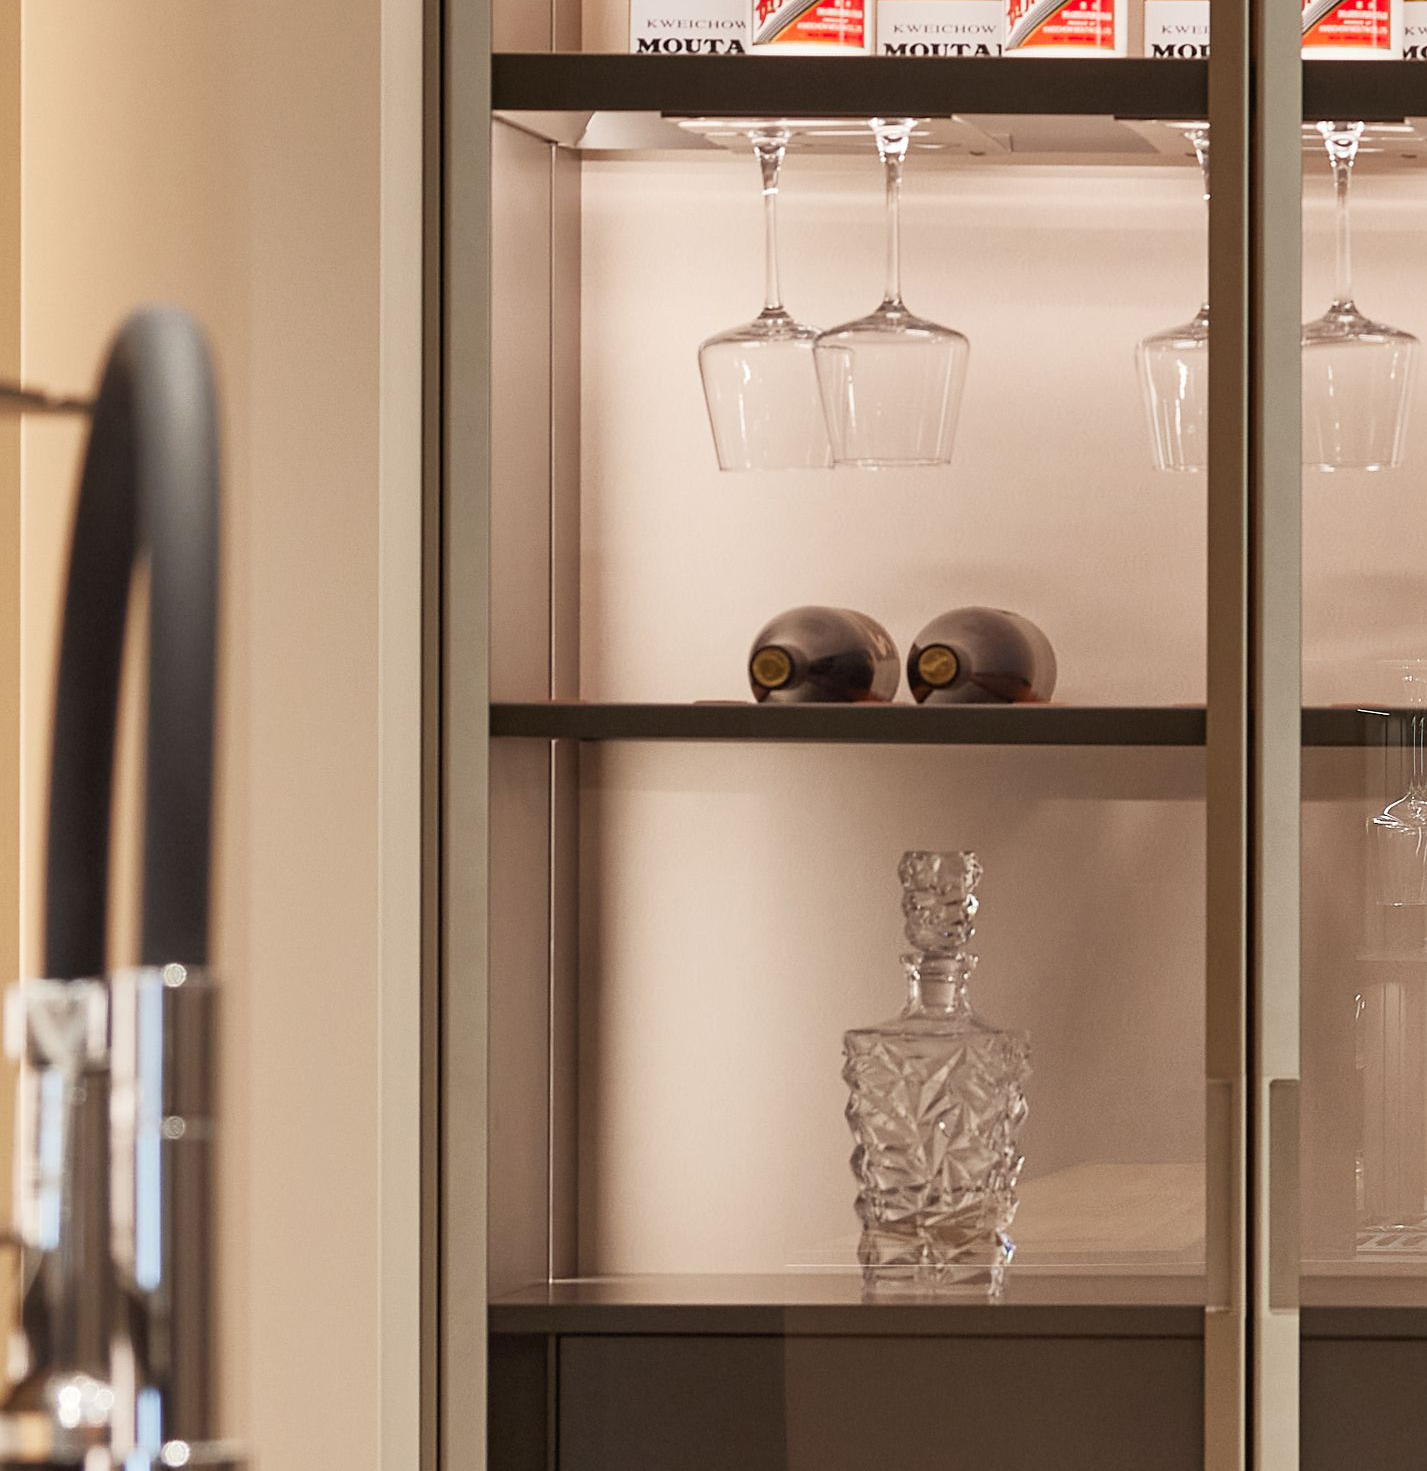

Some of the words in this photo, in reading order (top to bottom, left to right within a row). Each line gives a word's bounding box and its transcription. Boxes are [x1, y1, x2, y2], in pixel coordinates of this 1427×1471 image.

[646, 18, 747, 29] KWEICHOW
[893, 24, 998, 34] KWEICHOW
[636, 37, 746, 55] MOUTA
